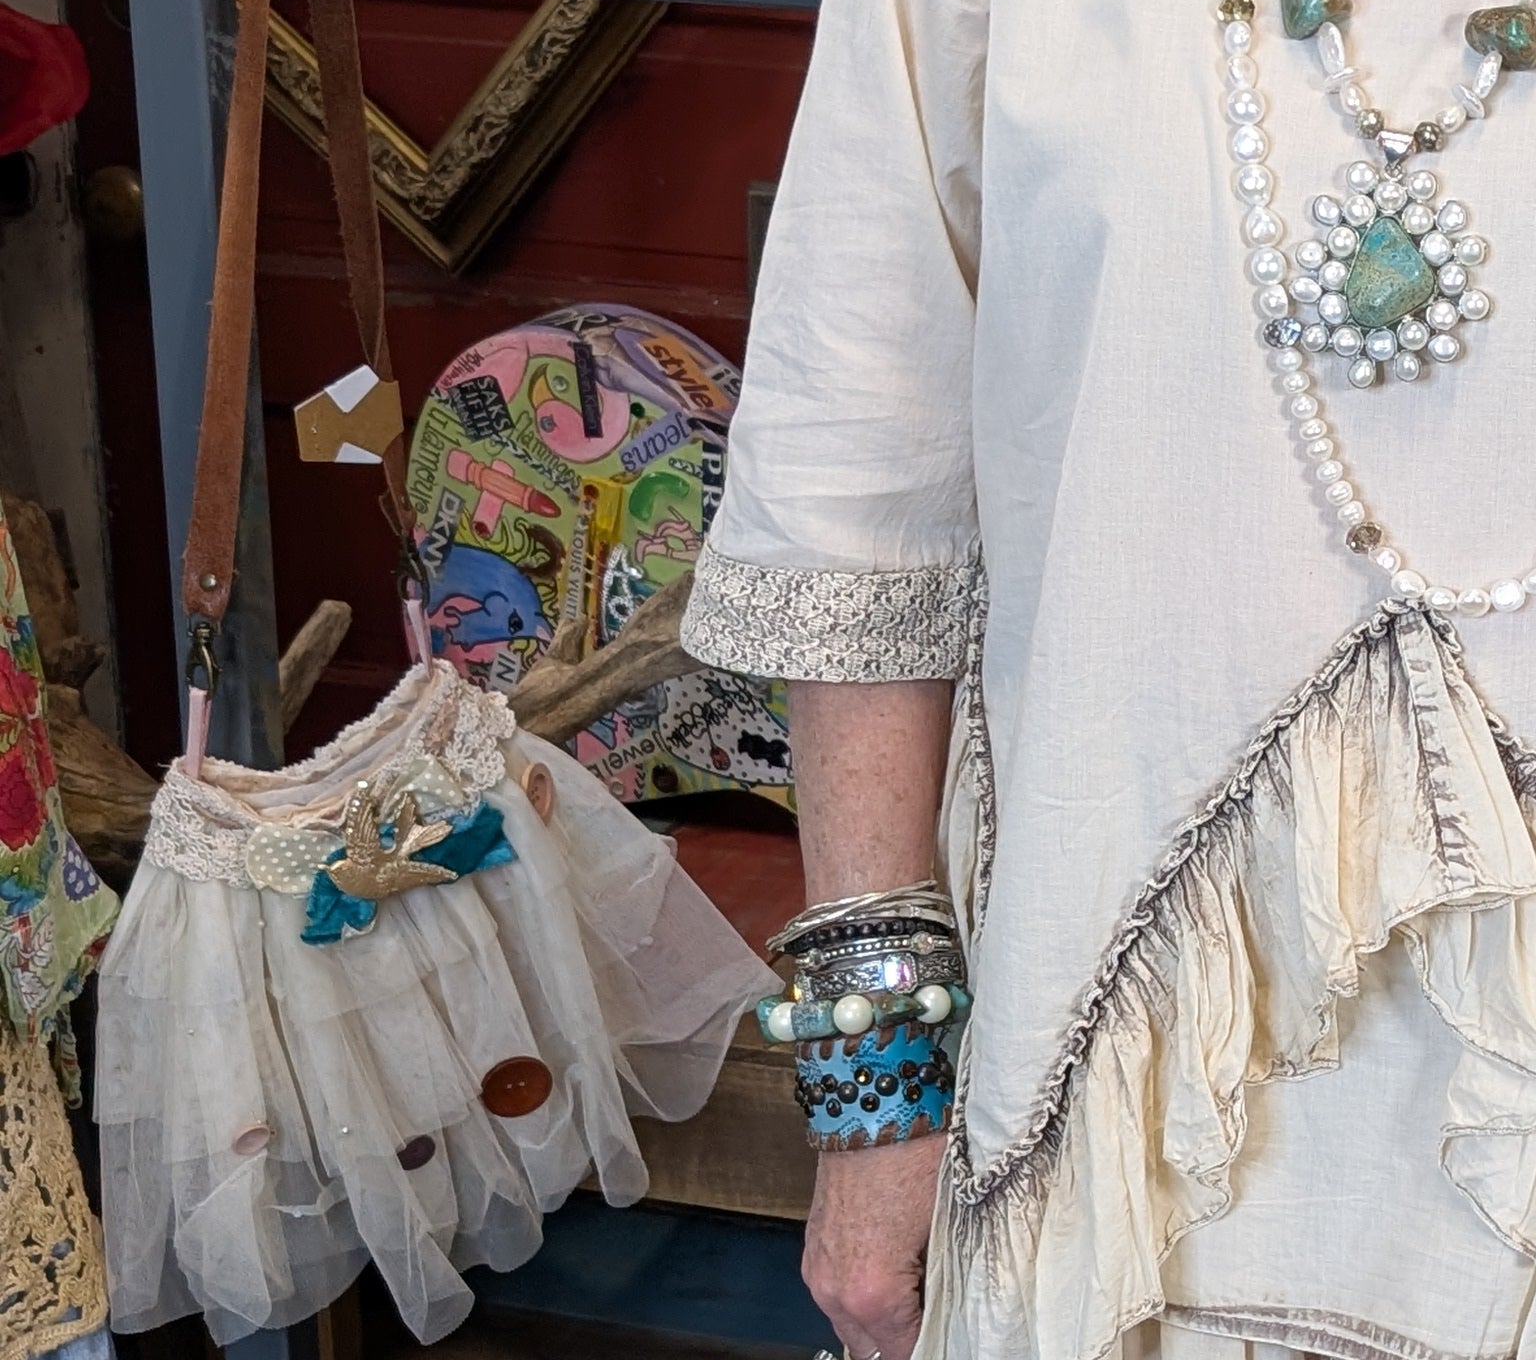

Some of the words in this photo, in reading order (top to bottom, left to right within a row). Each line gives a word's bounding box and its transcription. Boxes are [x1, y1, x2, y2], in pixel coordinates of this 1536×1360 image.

[476, 376, 513, 432] SAKS
[644, 344, 715, 410] style
[460, 380, 493, 438] FIFTH
[620, 411, 690, 472] jeans
[422, 490, 461, 578] DKNY
[568, 531, 585, 573] LOUIS
[496, 652, 517, 684] IN
